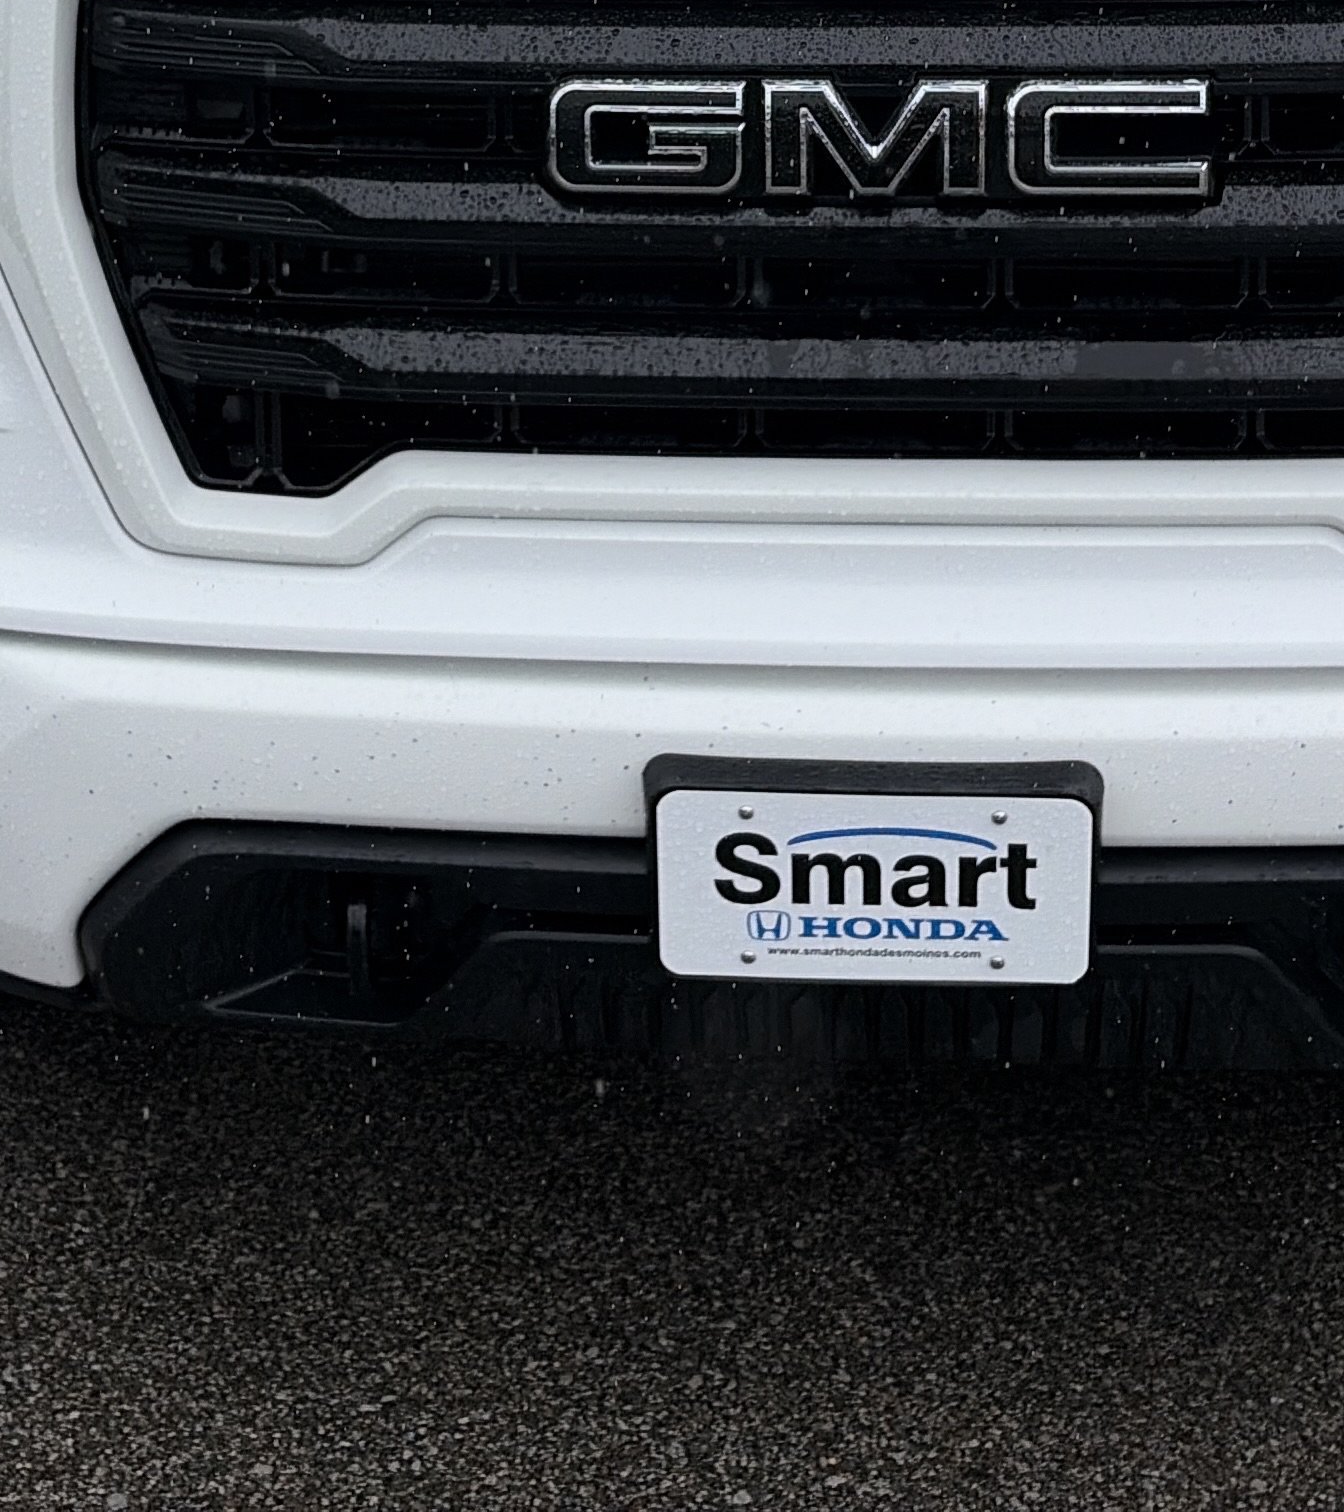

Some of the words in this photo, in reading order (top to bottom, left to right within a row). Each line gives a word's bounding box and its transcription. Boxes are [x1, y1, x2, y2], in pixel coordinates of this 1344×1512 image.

[548, 79, 1209, 195] GMC
[713, 832, 1037, 910] Smart
[767, 947, 981, 959] www.smarthondadesmoines.com
[798, 916, 1009, 941] HONDA
